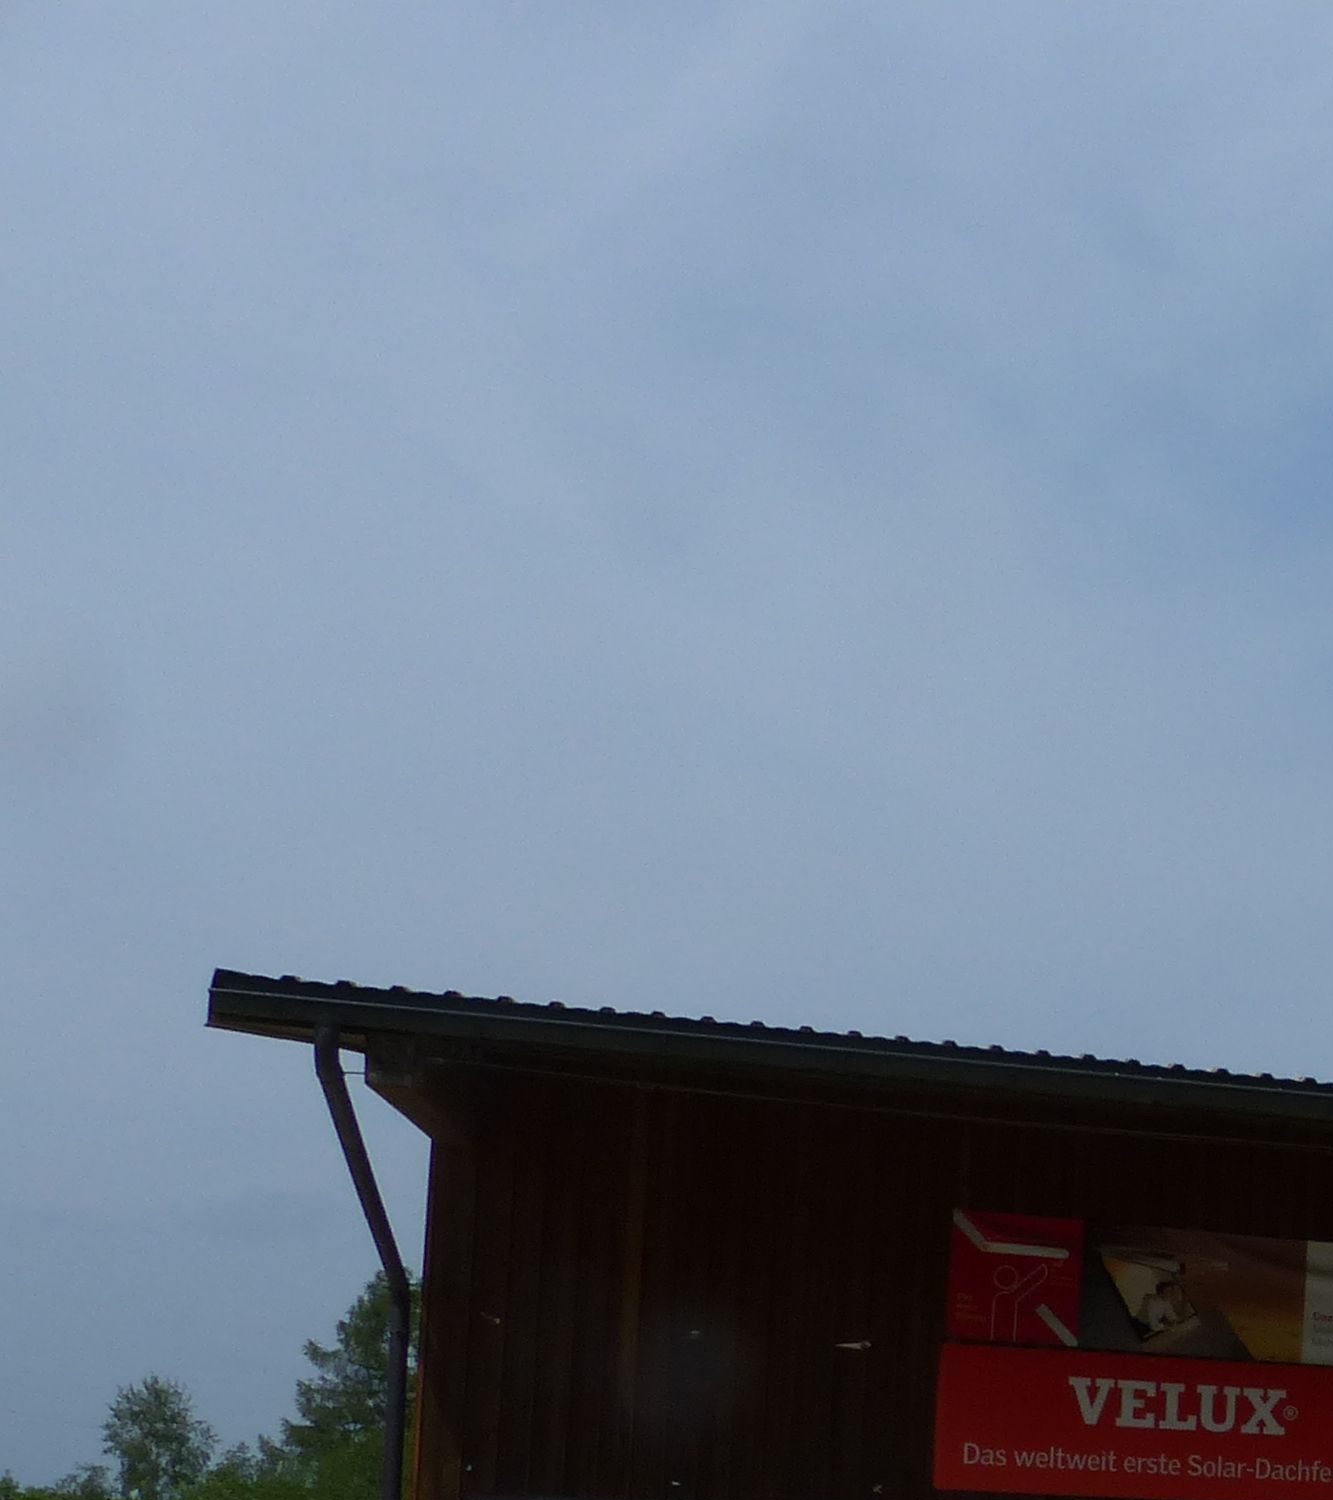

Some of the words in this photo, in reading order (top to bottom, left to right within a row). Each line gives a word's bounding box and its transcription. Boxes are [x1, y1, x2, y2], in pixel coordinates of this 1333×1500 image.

[963, 1442, 1007, 1467] Das
[1013, 1446, 1117, 1473] weltweit
[1123, 1454, 1181, 1476] erste
